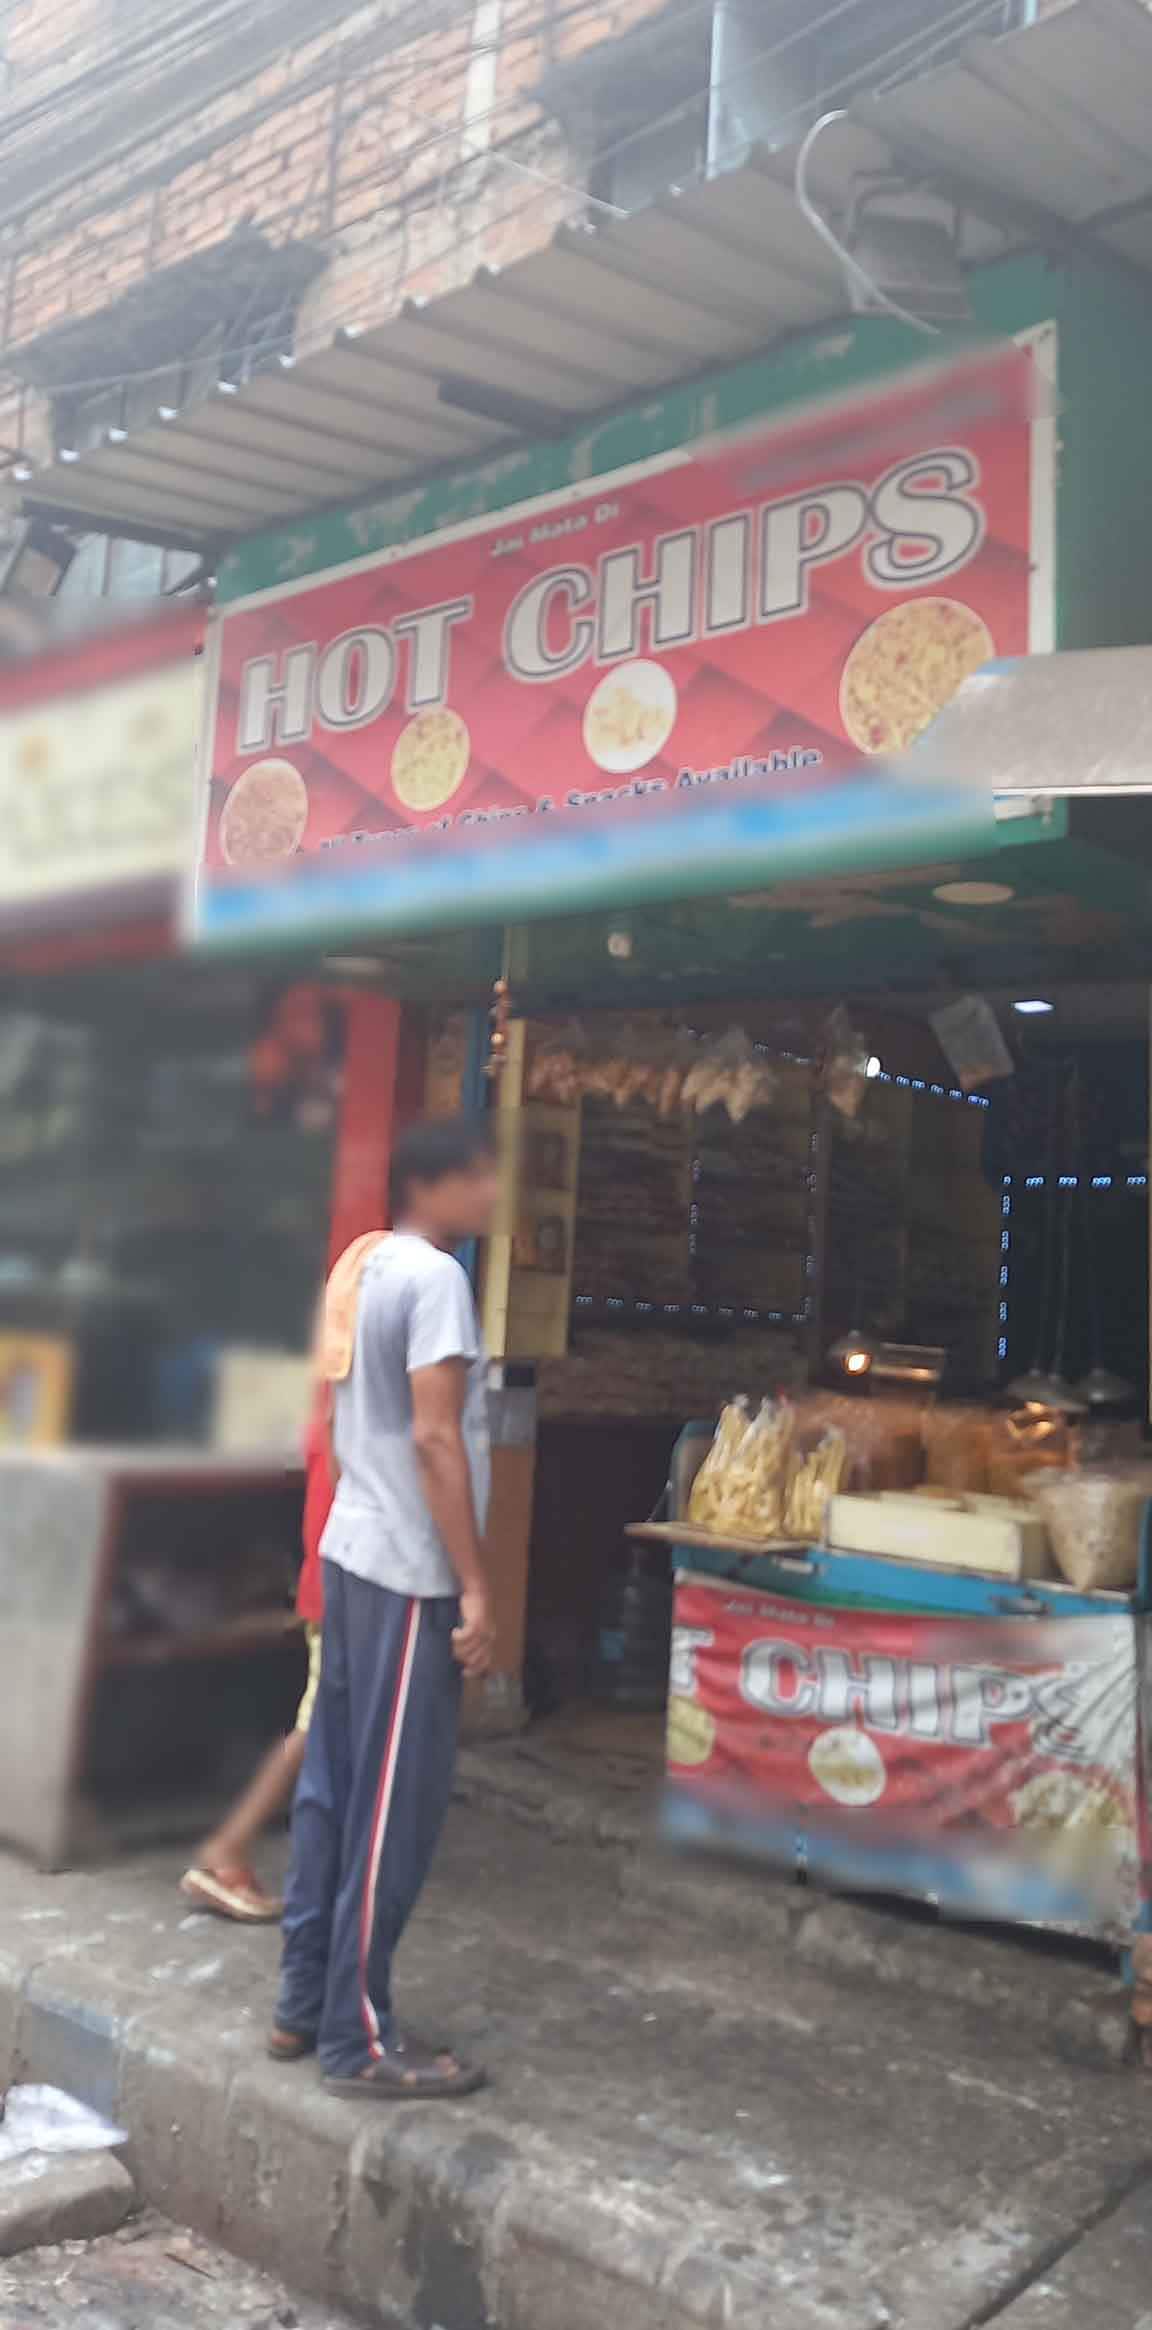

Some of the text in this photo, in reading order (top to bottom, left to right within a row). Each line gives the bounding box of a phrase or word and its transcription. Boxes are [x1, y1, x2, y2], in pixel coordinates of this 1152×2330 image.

[236, 445, 985, 755] HOT CHIPS
[675, 744, 823, 790] Available
